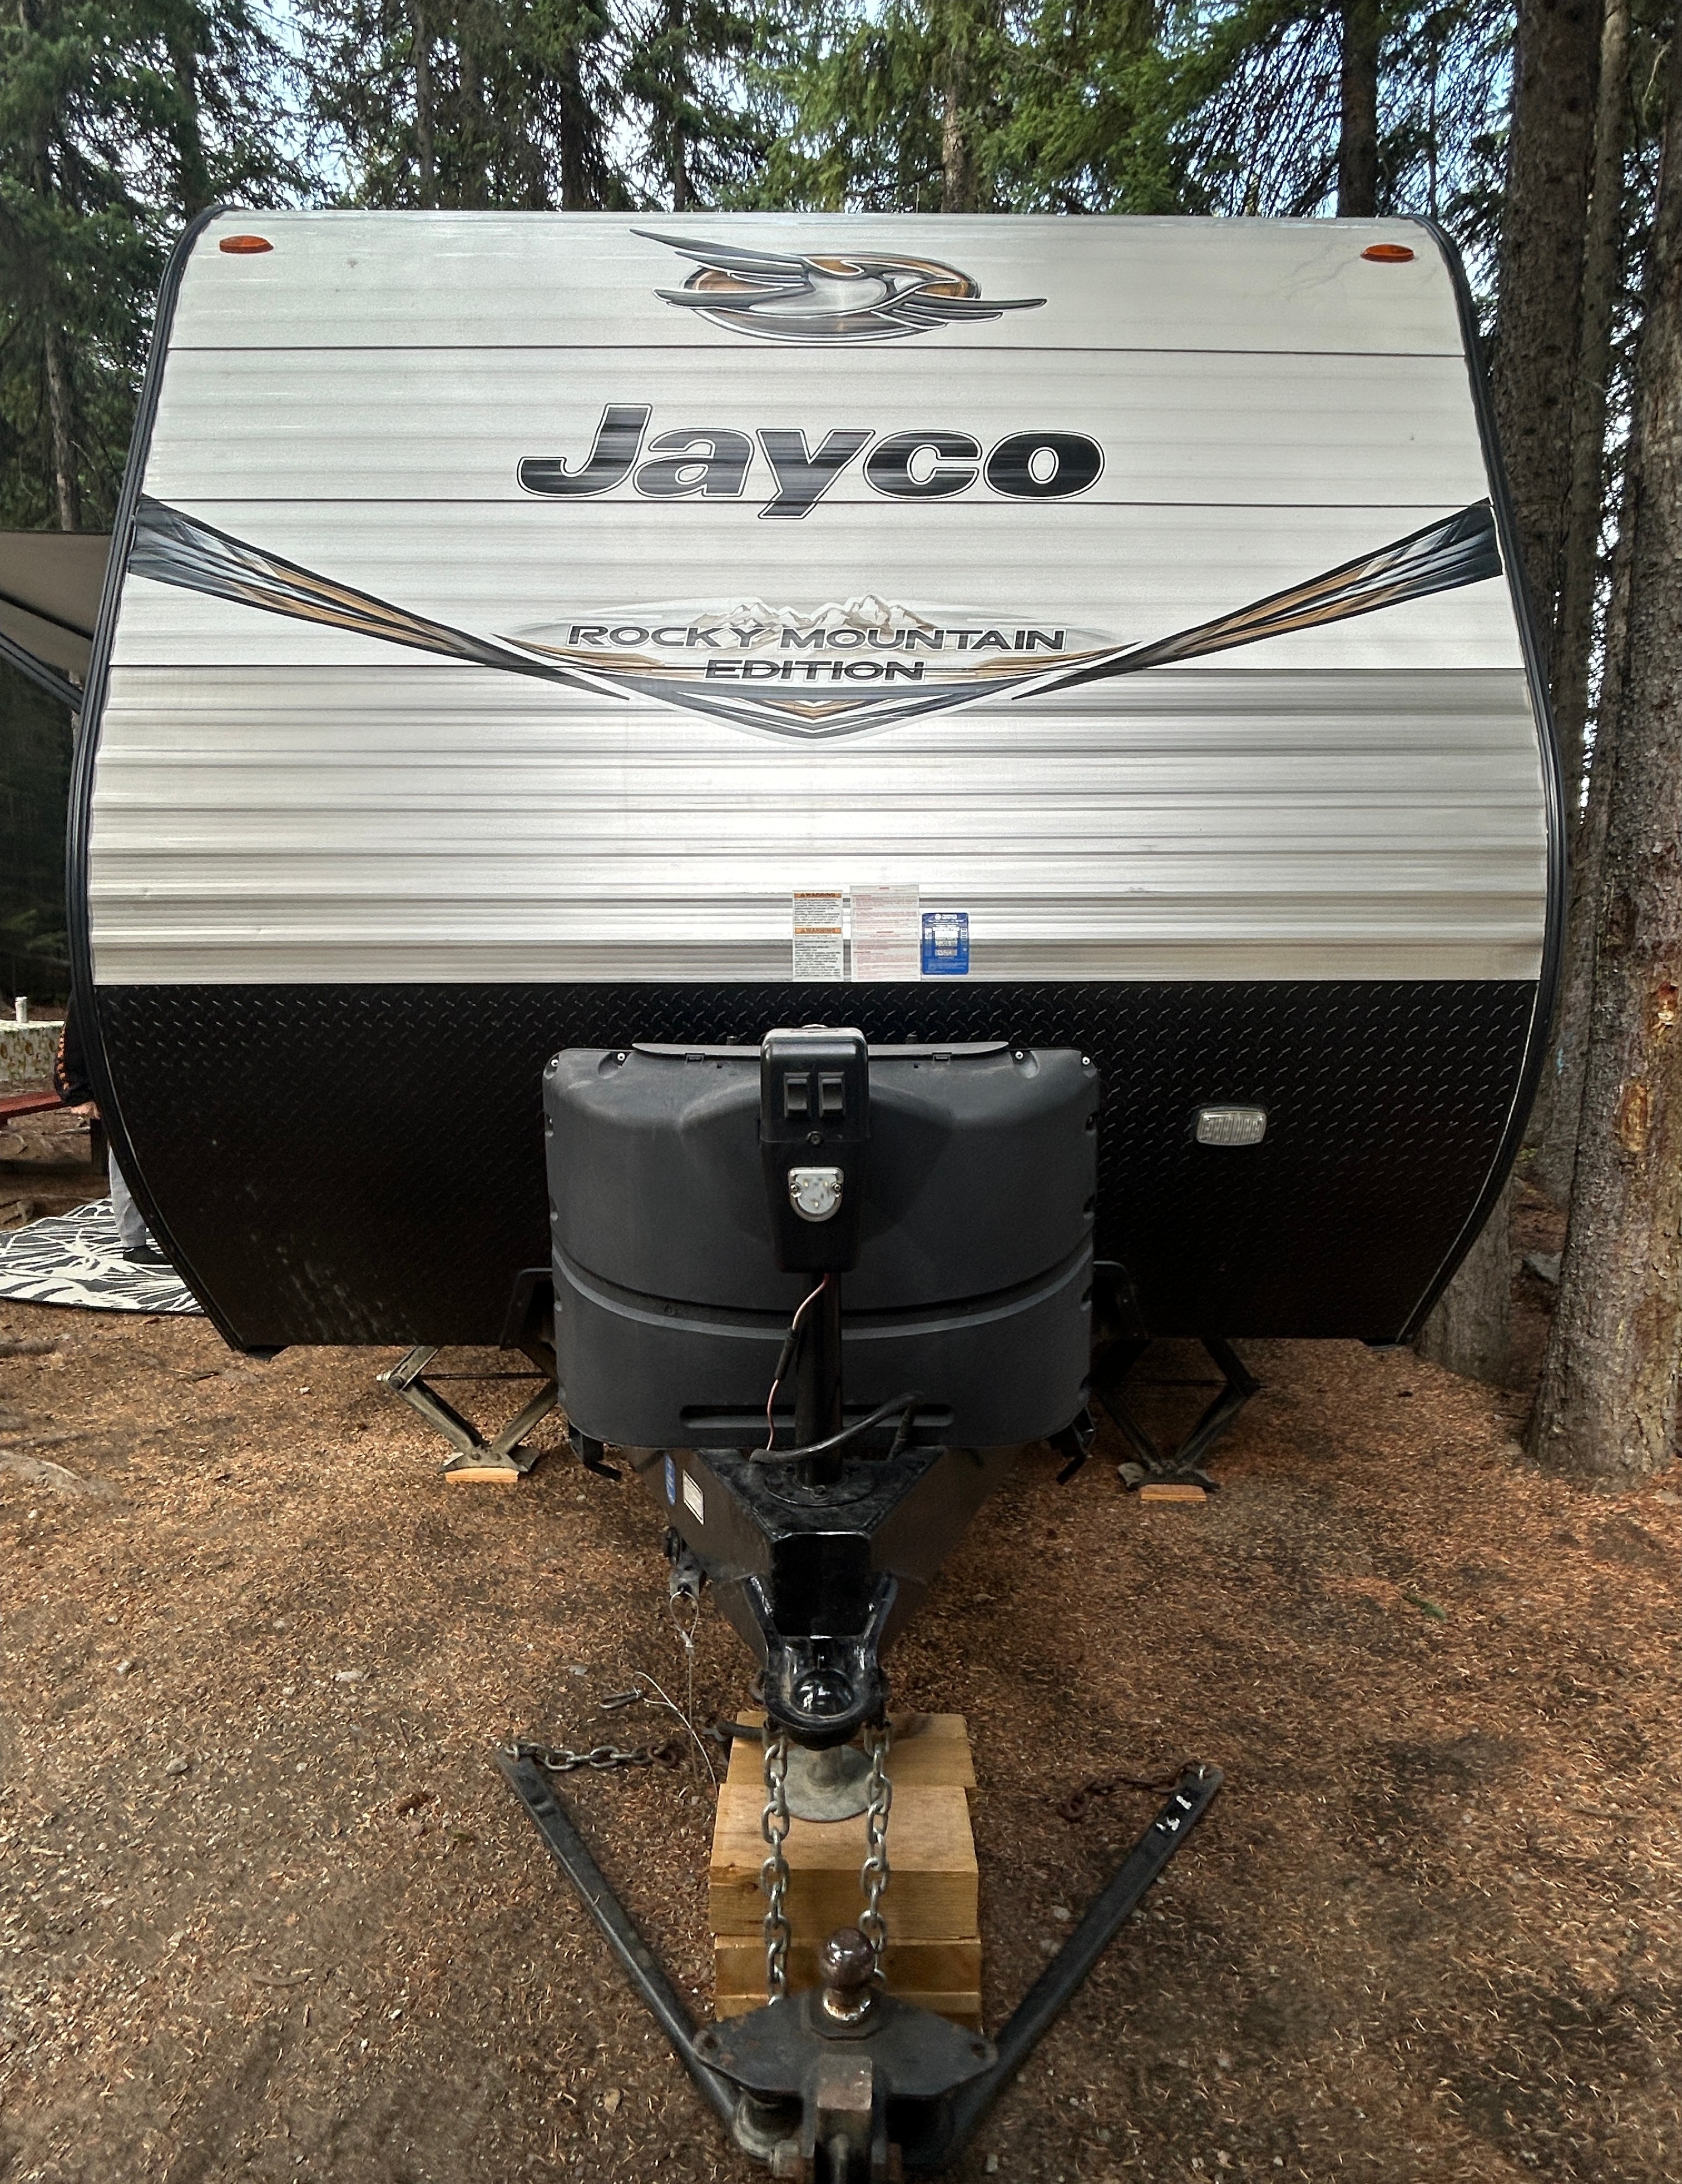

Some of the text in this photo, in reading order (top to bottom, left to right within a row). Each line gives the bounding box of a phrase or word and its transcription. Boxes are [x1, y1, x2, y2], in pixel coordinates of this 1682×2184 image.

[517, 404, 1105, 519] Jayco
[568, 625, 1065, 650] ROCKY MOUNTAIN
[705, 659, 924, 681] EDITION
